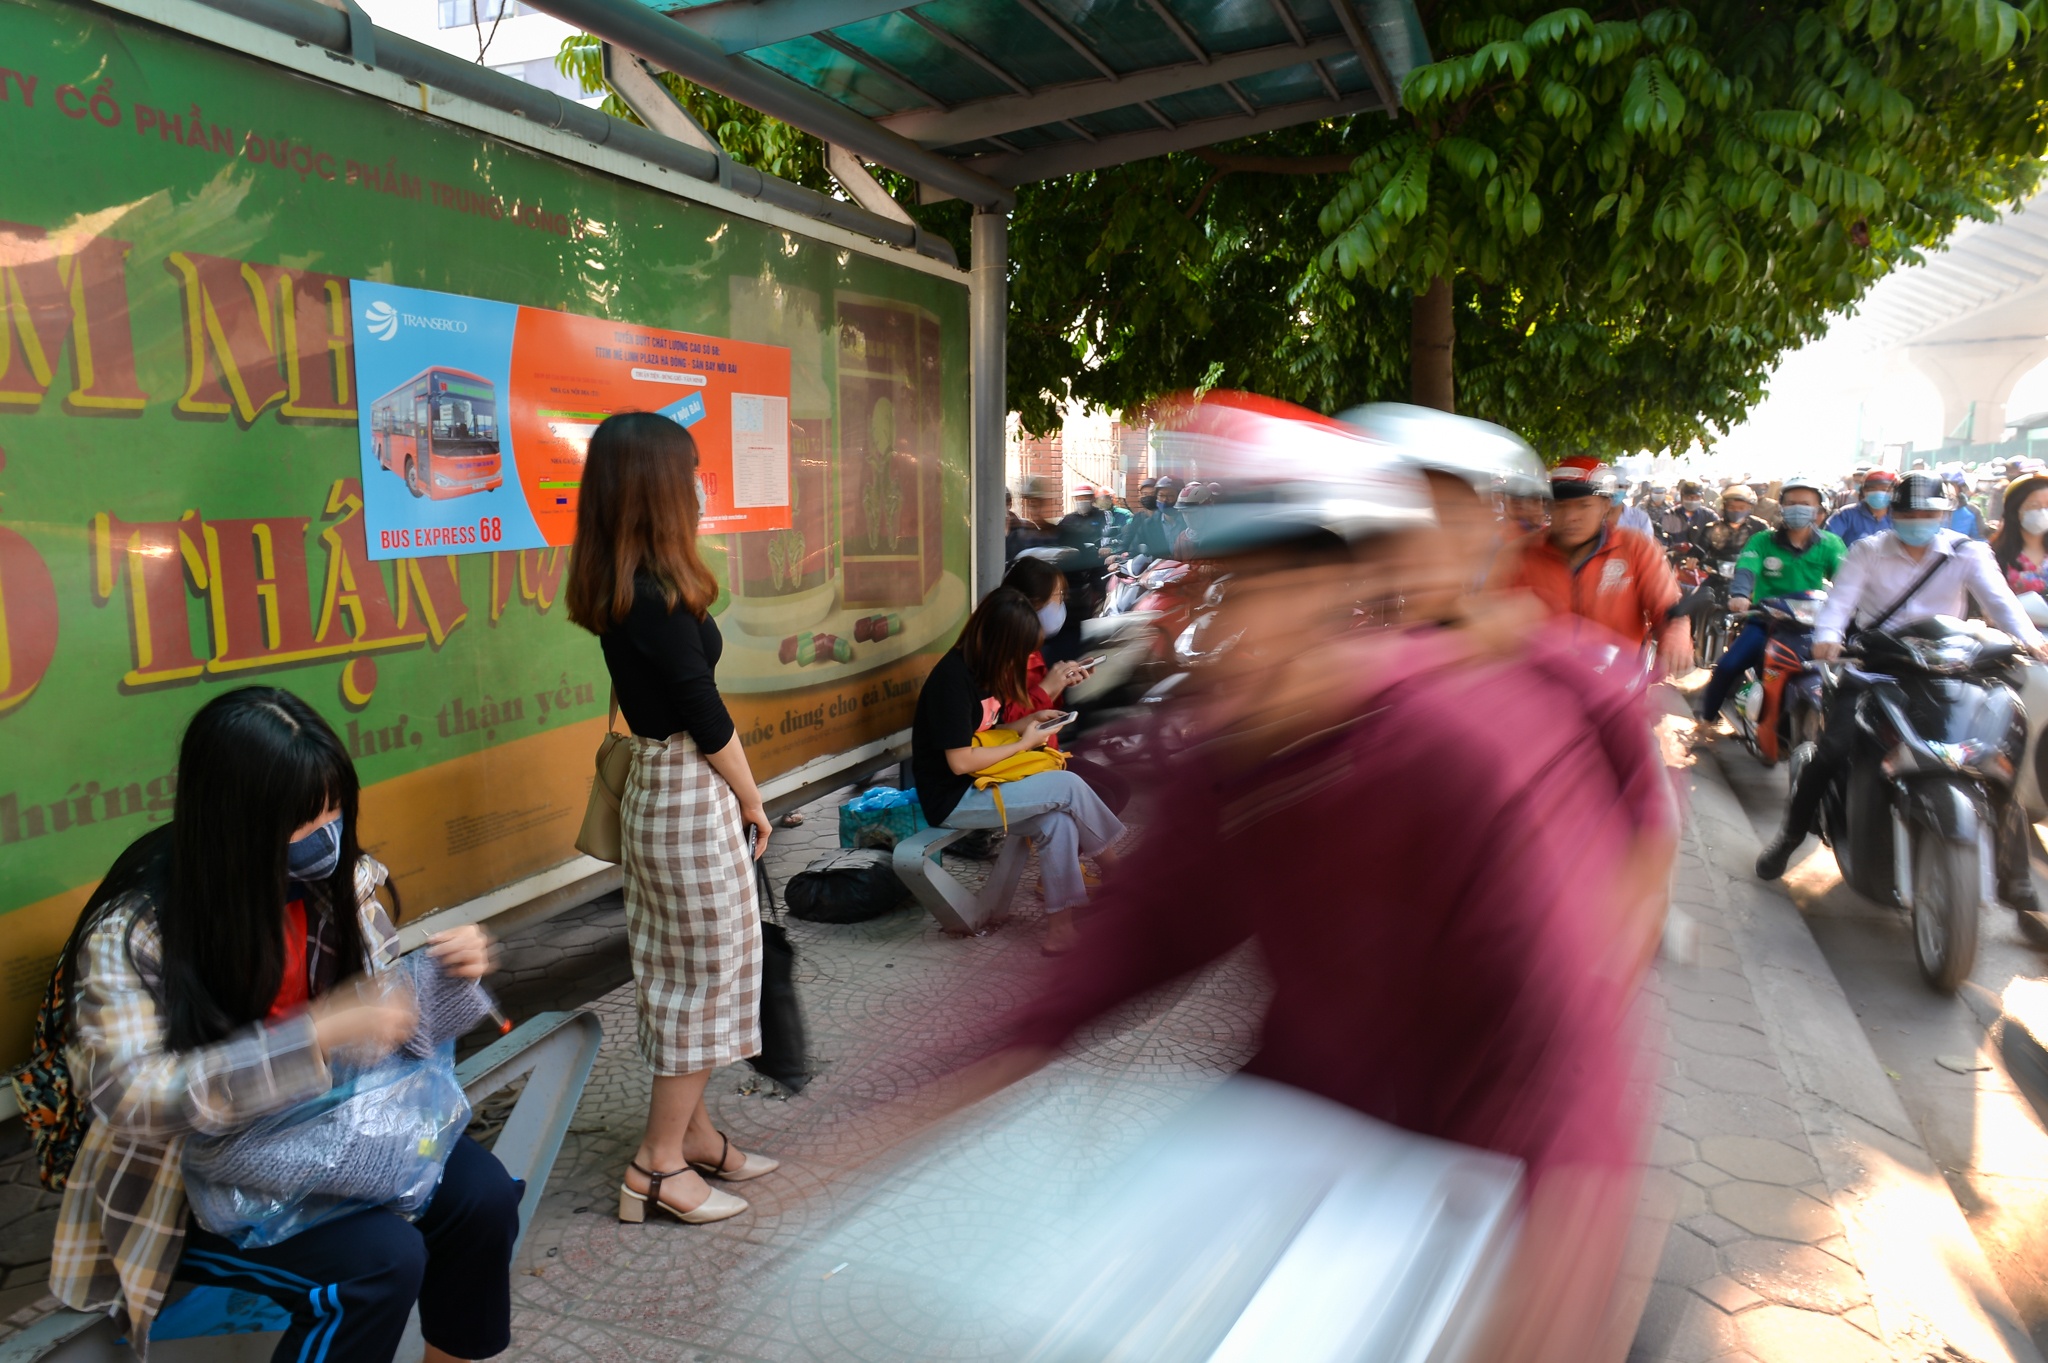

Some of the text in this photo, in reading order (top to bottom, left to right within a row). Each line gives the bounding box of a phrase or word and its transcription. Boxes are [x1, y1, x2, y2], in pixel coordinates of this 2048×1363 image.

[0, 67, 38, 108] TY
[55, 77, 122, 128] CỔ
[133, 102, 236, 158] PHẦN
[429, 181, 504, 221] TRUNG
[402, 313, 467, 334] TRANSERCO
[380, 516, 502, 549] BUS EXPRESS 68
[780, 703, 825, 736] dùng
[829, 693, 858, 719] cho
[881, 676, 911, 702] Nam
[0, 765, 180, 845] hứng
[436, 694, 525, 741] thận
[534, 671, 596, 726] yếu
